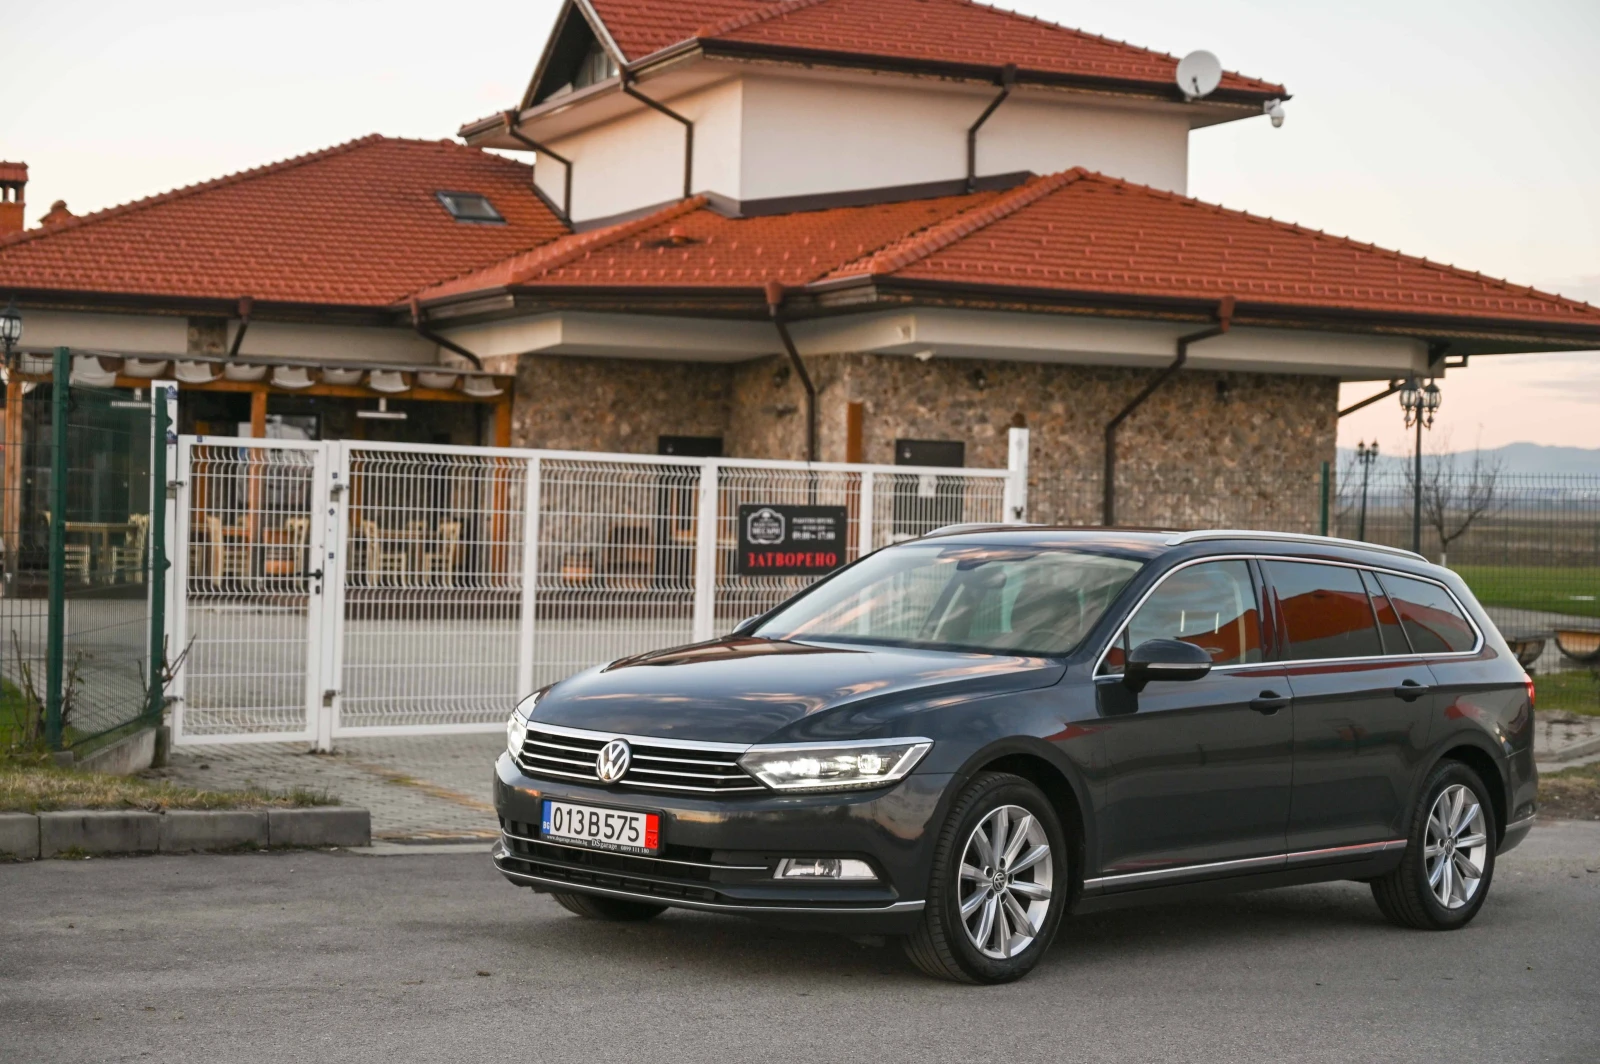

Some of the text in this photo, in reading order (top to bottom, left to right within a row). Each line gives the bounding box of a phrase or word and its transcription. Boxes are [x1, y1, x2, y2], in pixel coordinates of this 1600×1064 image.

[747, 552, 837, 567] ЗАТВОРЕНО
[542, 821, 551, 830] BG
[553, 806, 640, 843] 013B575
